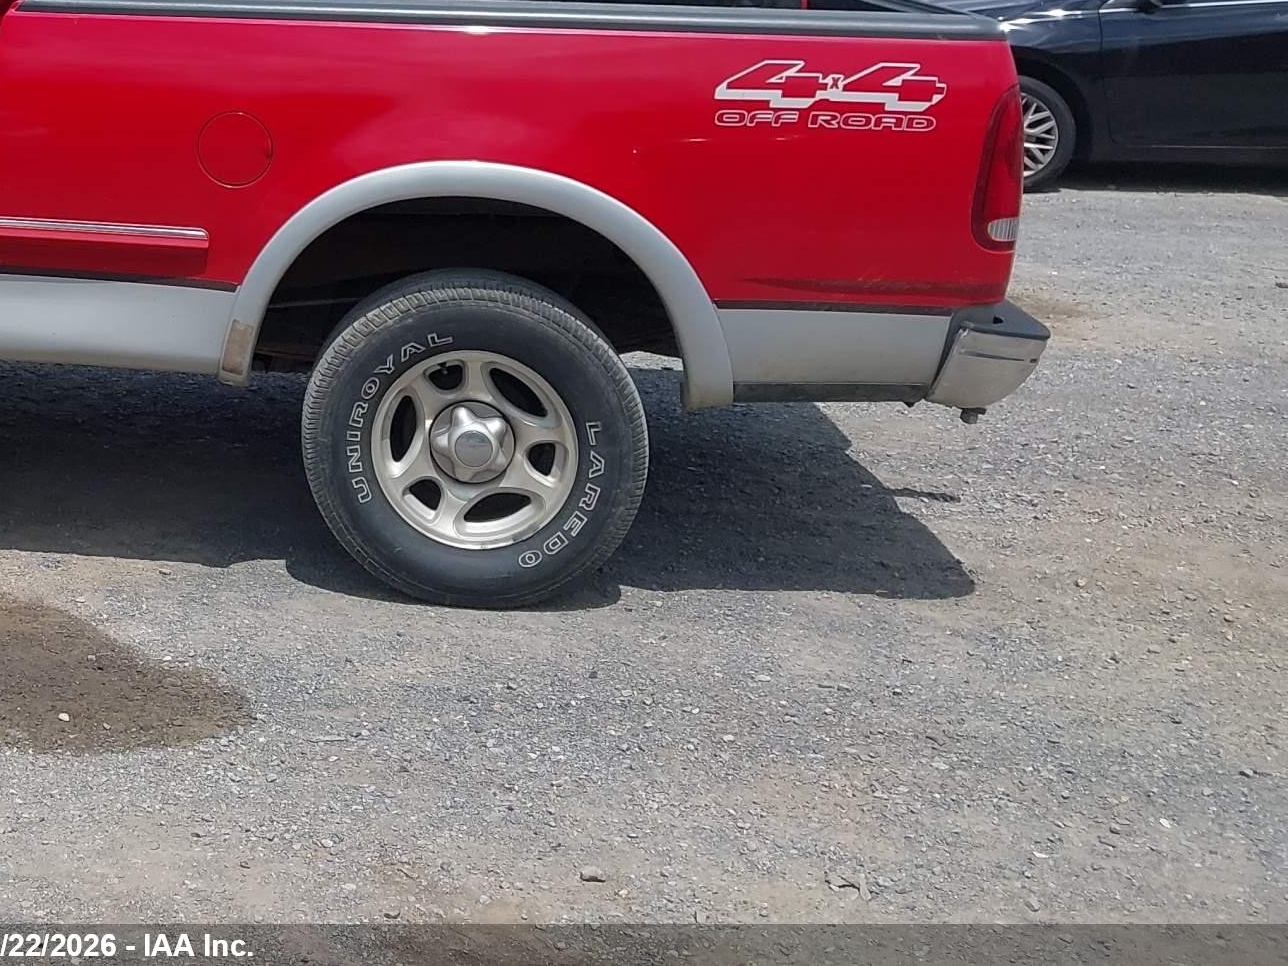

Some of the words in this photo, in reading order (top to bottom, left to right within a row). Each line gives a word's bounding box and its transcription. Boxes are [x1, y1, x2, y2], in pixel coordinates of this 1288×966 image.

[714, 60, 947, 111] 4x4
[715, 110, 800, 126] OFF
[808, 111, 937, 132] ROAD
[346, 333, 454, 504] UNIROYAL
[518, 421, 605, 568] LAREDO
